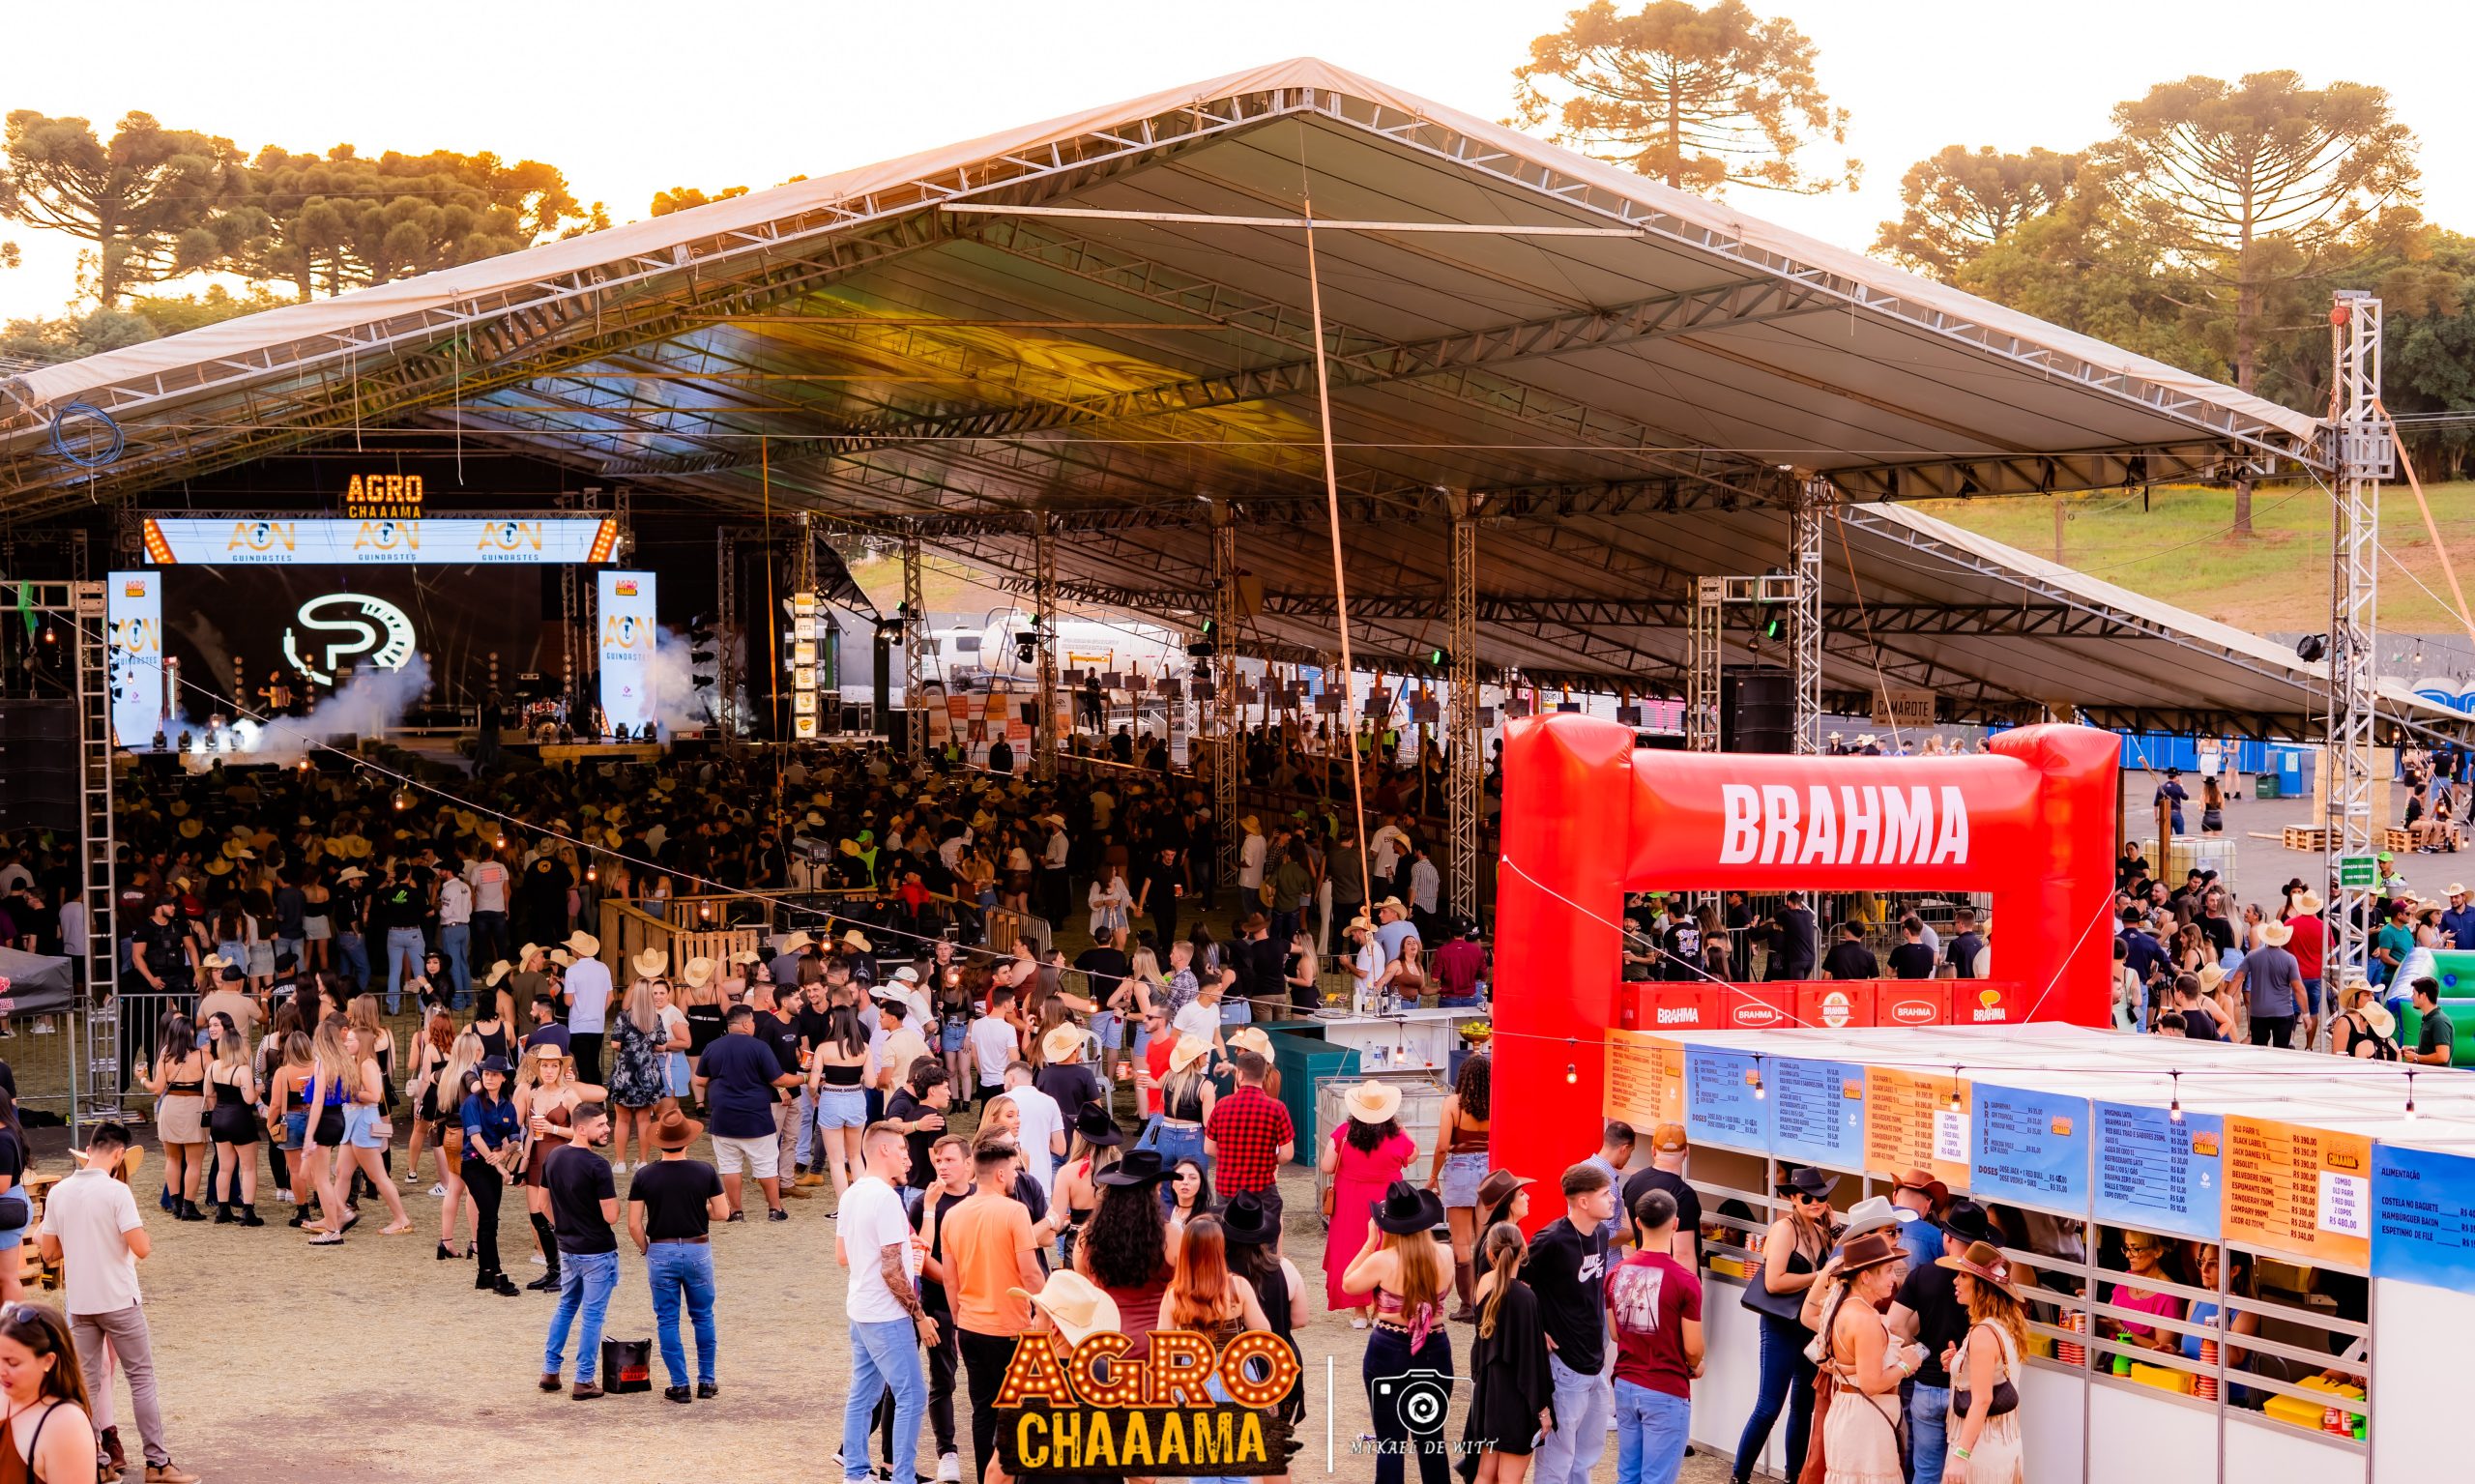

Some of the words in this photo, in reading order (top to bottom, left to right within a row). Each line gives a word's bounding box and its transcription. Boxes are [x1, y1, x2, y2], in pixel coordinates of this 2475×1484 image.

[347, 475, 422, 502] AGRO
[349, 506, 421, 518] CHAAAMA
[1878, 700, 1928, 716] CAMAROTE
[1719, 784, 1968, 864] BRAHMA
[1657, 1007, 1699, 1023] BRAHMA
[1738, 1010, 1772, 1019] BRAHMA
[1823, 1005, 1849, 1015] BRAHMA
[1897, 1007, 1932, 1016] BRAHMA
[1974, 1008, 2005, 1021] BRAHMA
[2243, 1126, 2255, 1135] PARR
[2301, 1136, 2316, 1146] 390,00
[2233, 1136, 2247, 1146] BLACK
[2249, 1139, 2261, 1148] LABEL
[2301, 1148, 2316, 1158] 390,00
[2233, 1148, 2244, 1156] JACK
[2301, 1160, 2316, 1170] 390,00
[1979, 1165, 1997, 1176] DOSES
[2232, 1159, 2254, 1169] ABSOLUT
[2300, 1172, 2316, 1181] 300,00
[2382, 1168, 2420, 1179] ALIMENTAÇÃO
[2232, 1171, 2258, 1182] BELVEDERE
[2292, 1182, 2299, 1191] R$
[2300, 1183, 2315, 1194] 380,00
[2232, 1182, 2259, 1193] ESPUMANTE
[2335, 1177, 2351, 1186] COMBO
[2342, 1188, 2353, 1197] PARR
[2232, 1193, 2259, 1205] TANQUERAY
[2260, 1198, 2274, 1208] 750ML
[2299, 1208, 2315, 1218] 300,00
[2344, 1198, 2355, 1207] BULL
[2382, 1197, 2404, 1208] COSTELA
[2406, 1200, 2413, 1208] NO
[2415, 1201, 2438, 1212] BAGUETE
[2460, 1208, 2467, 1216] R$
[2231, 1205, 2254, 1215] CAMPARY
[2255, 1208, 2269, 1218] 990ML
[2291, 1218, 2297, 1227] R$
[2299, 1219, 2315, 1230] 230,00
[2329, 1216, 2336, 1225] R$
[2338, 1218, 2356, 1229] 480,00
[2382, 1211, 2420, 1224] HAMBÚRGUER
[2422, 1217, 2438, 1228] BACON
[2461, 1223, 2468, 1232] R$
[2231, 1216, 2244, 1225] LICOR
[2298, 1232, 2314, 1241] 340,00
[2382, 1226, 2412, 1237] ESPETINHO
[2415, 1231, 2421, 1239] DE
[2423, 1231, 2432, 1241] FILÉ
[1584, 1254, 1600, 1268] NIKE
